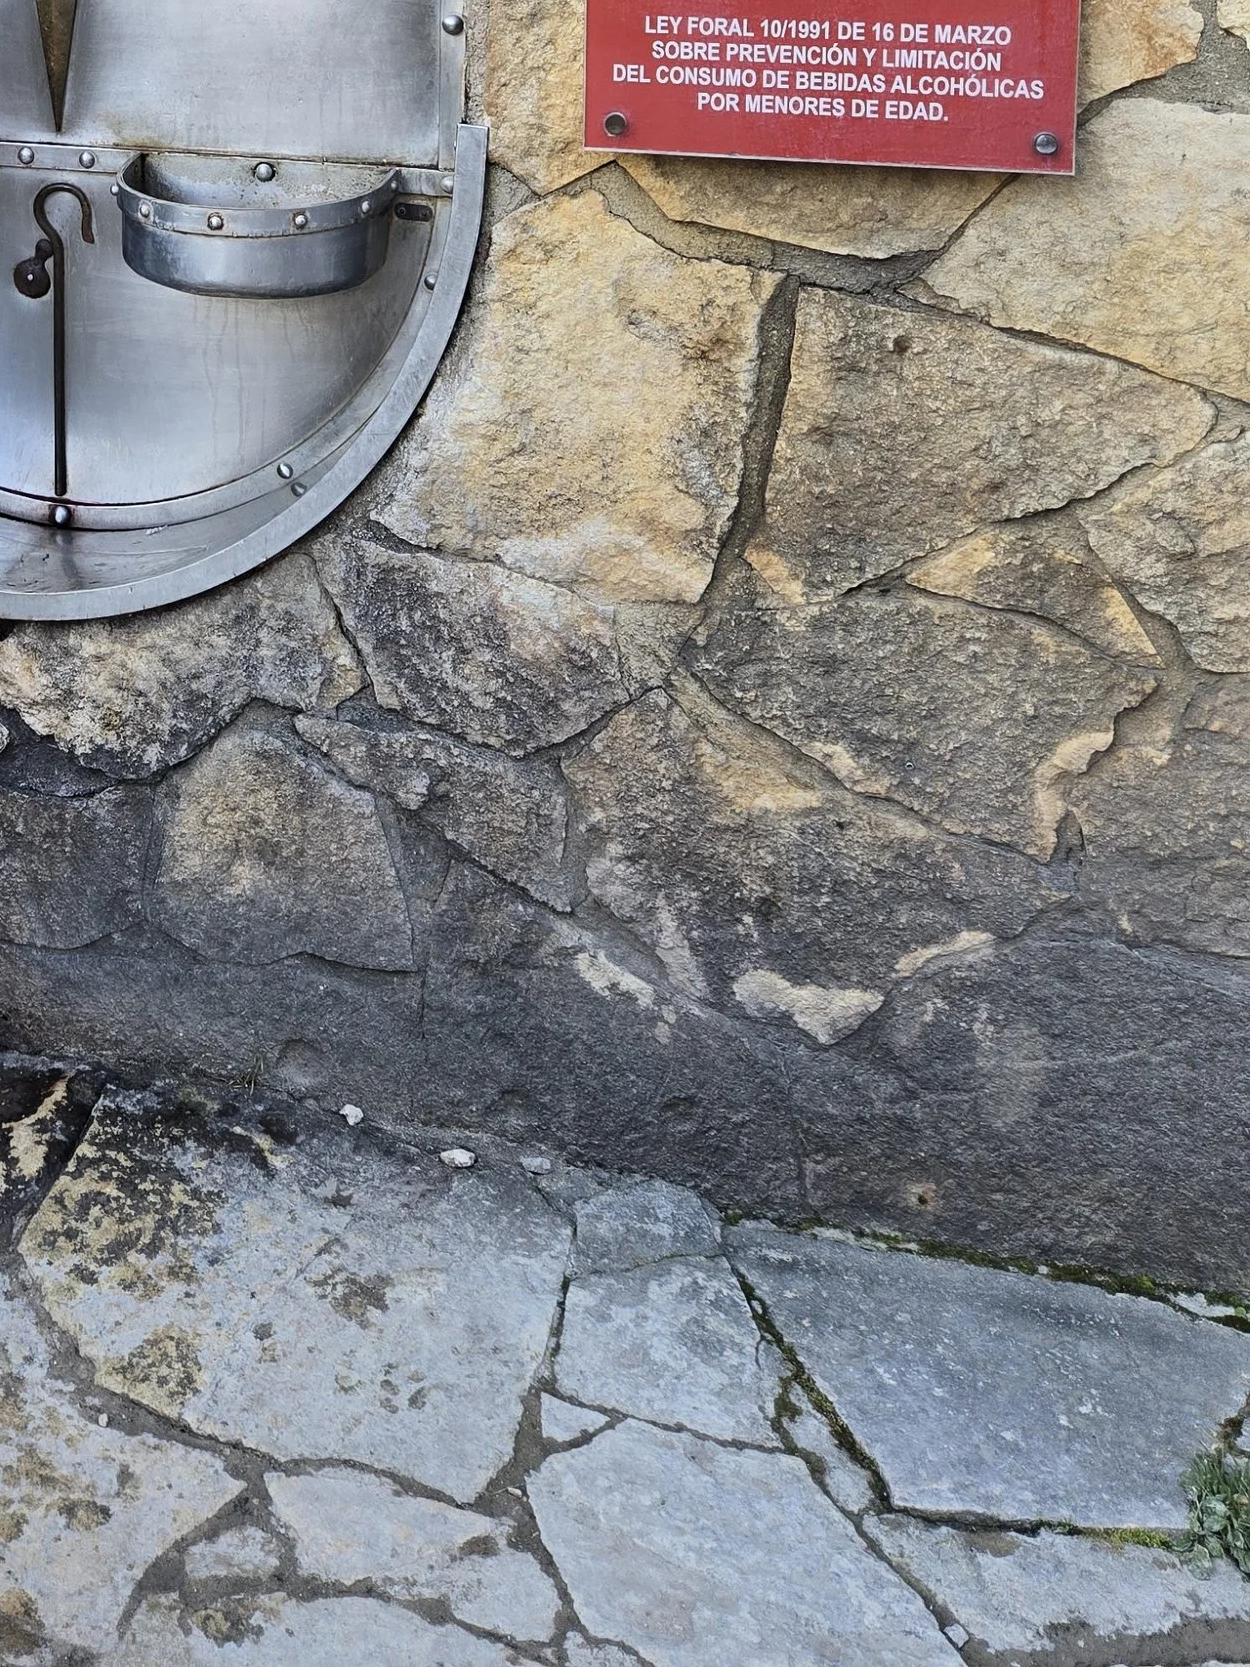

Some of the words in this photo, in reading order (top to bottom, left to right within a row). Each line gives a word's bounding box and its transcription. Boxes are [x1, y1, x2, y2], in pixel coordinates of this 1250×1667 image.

[645, 15, 682, 35] LEY
[687, 17, 755, 37] FORAL
[760, 19, 830, 39] 10/1991
[837, 21, 866, 41] DE
[872, 22, 894, 42] 16
[900, 23, 929, 43] DE
[934, 25, 1012, 46] MARZO
[652, 40, 720, 61] SOBRE
[726, 42, 857, 66] PREVENCIÓN
[862, 47, 878, 66] Y
[882, 47, 1002, 72] LIMITACIÓN
[612, 64, 651, 83] DEL
[656, 65, 757, 88] CONSUMO
[762, 70, 790, 89] DE
[795, 71, 886, 93] BEBIDAS
[890, 74, 1044, 100] ALCOHÓLICAS
[697, 93, 740, 112] POR
[745, 94, 846, 117] MENORES
[851, 99, 879, 118] DE
[885, 101, 949, 121] EDAD.
